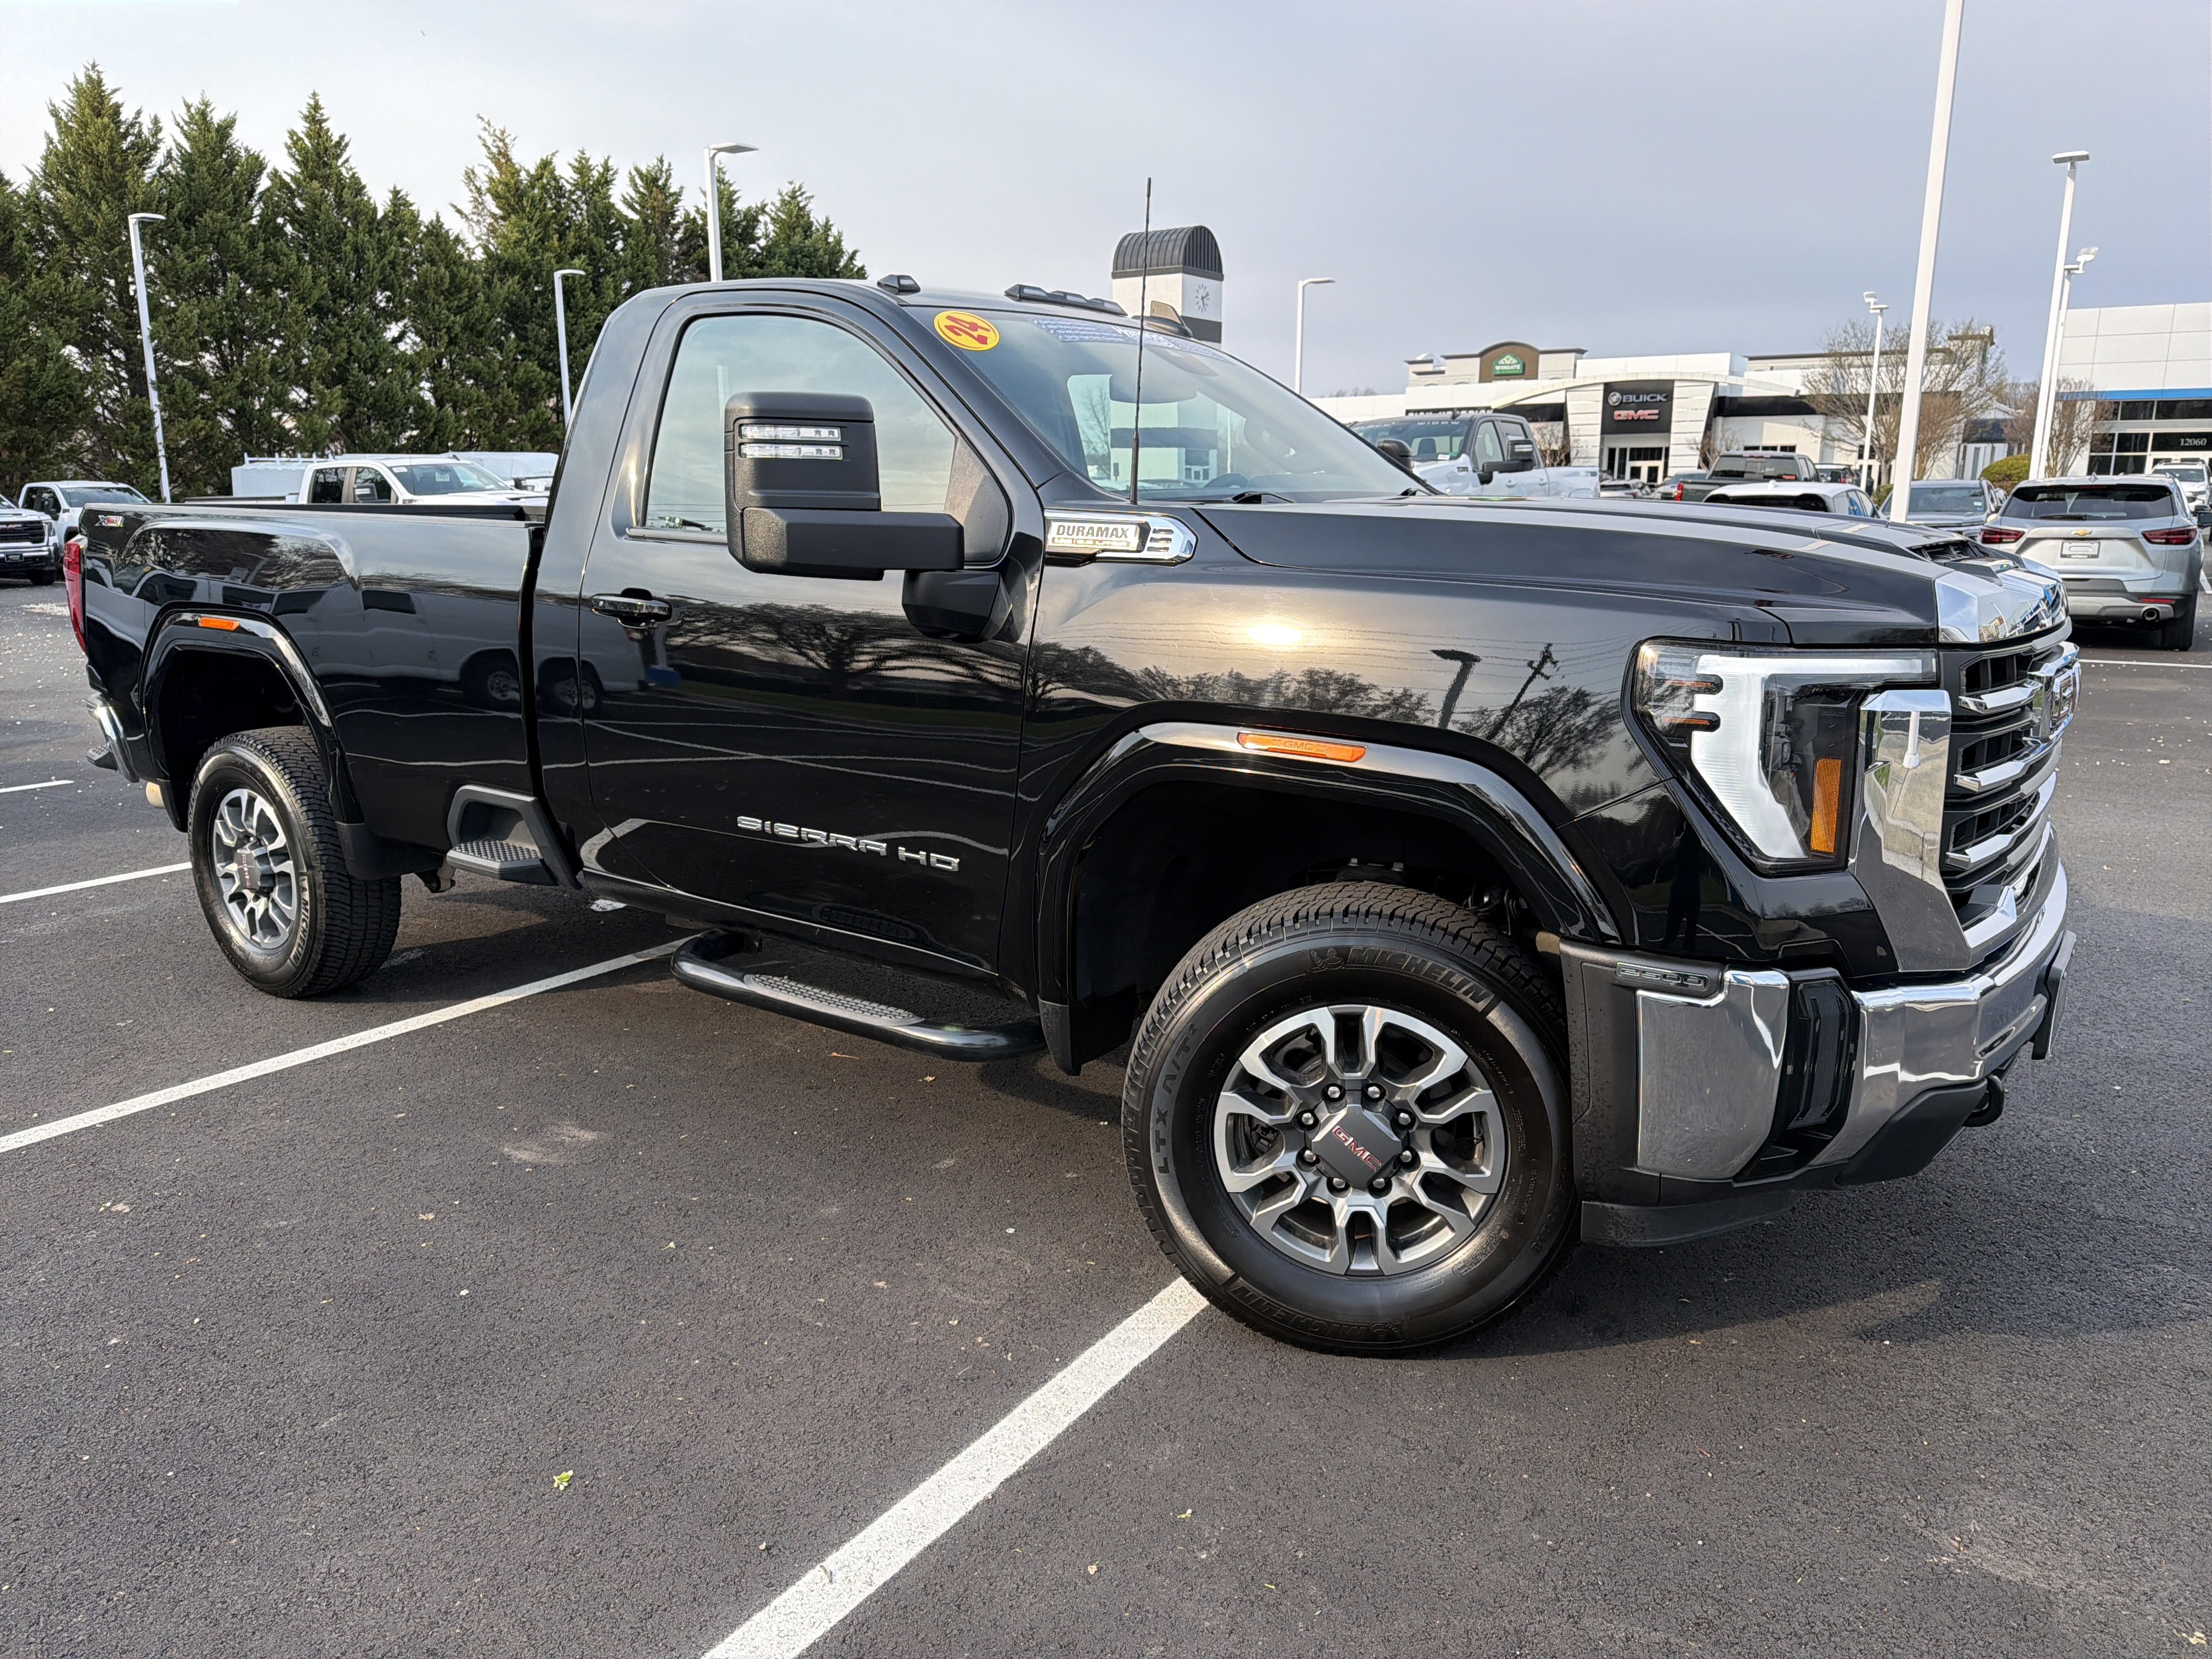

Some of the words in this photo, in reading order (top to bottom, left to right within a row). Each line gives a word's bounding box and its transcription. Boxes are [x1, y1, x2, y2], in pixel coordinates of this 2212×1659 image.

[944, 314, 991, 345] 24
[1622, 394, 1668, 403] BUICK
[1613, 409, 1660, 420] GMC
[2180, 438, 2207, 446] 12060
[1056, 524, 1130, 539] DURAMAX
[737, 816, 888, 856] SIERRA
[898, 846, 960, 872] HD
[292, 897, 309, 964] MICHELIN
[1346, 946, 1488, 1004] MICHELIN
[1620, 967, 1704, 987] 2500
[1154, 1106, 1170, 1174] LTX
[1331, 1125, 1383, 1171] GMC
